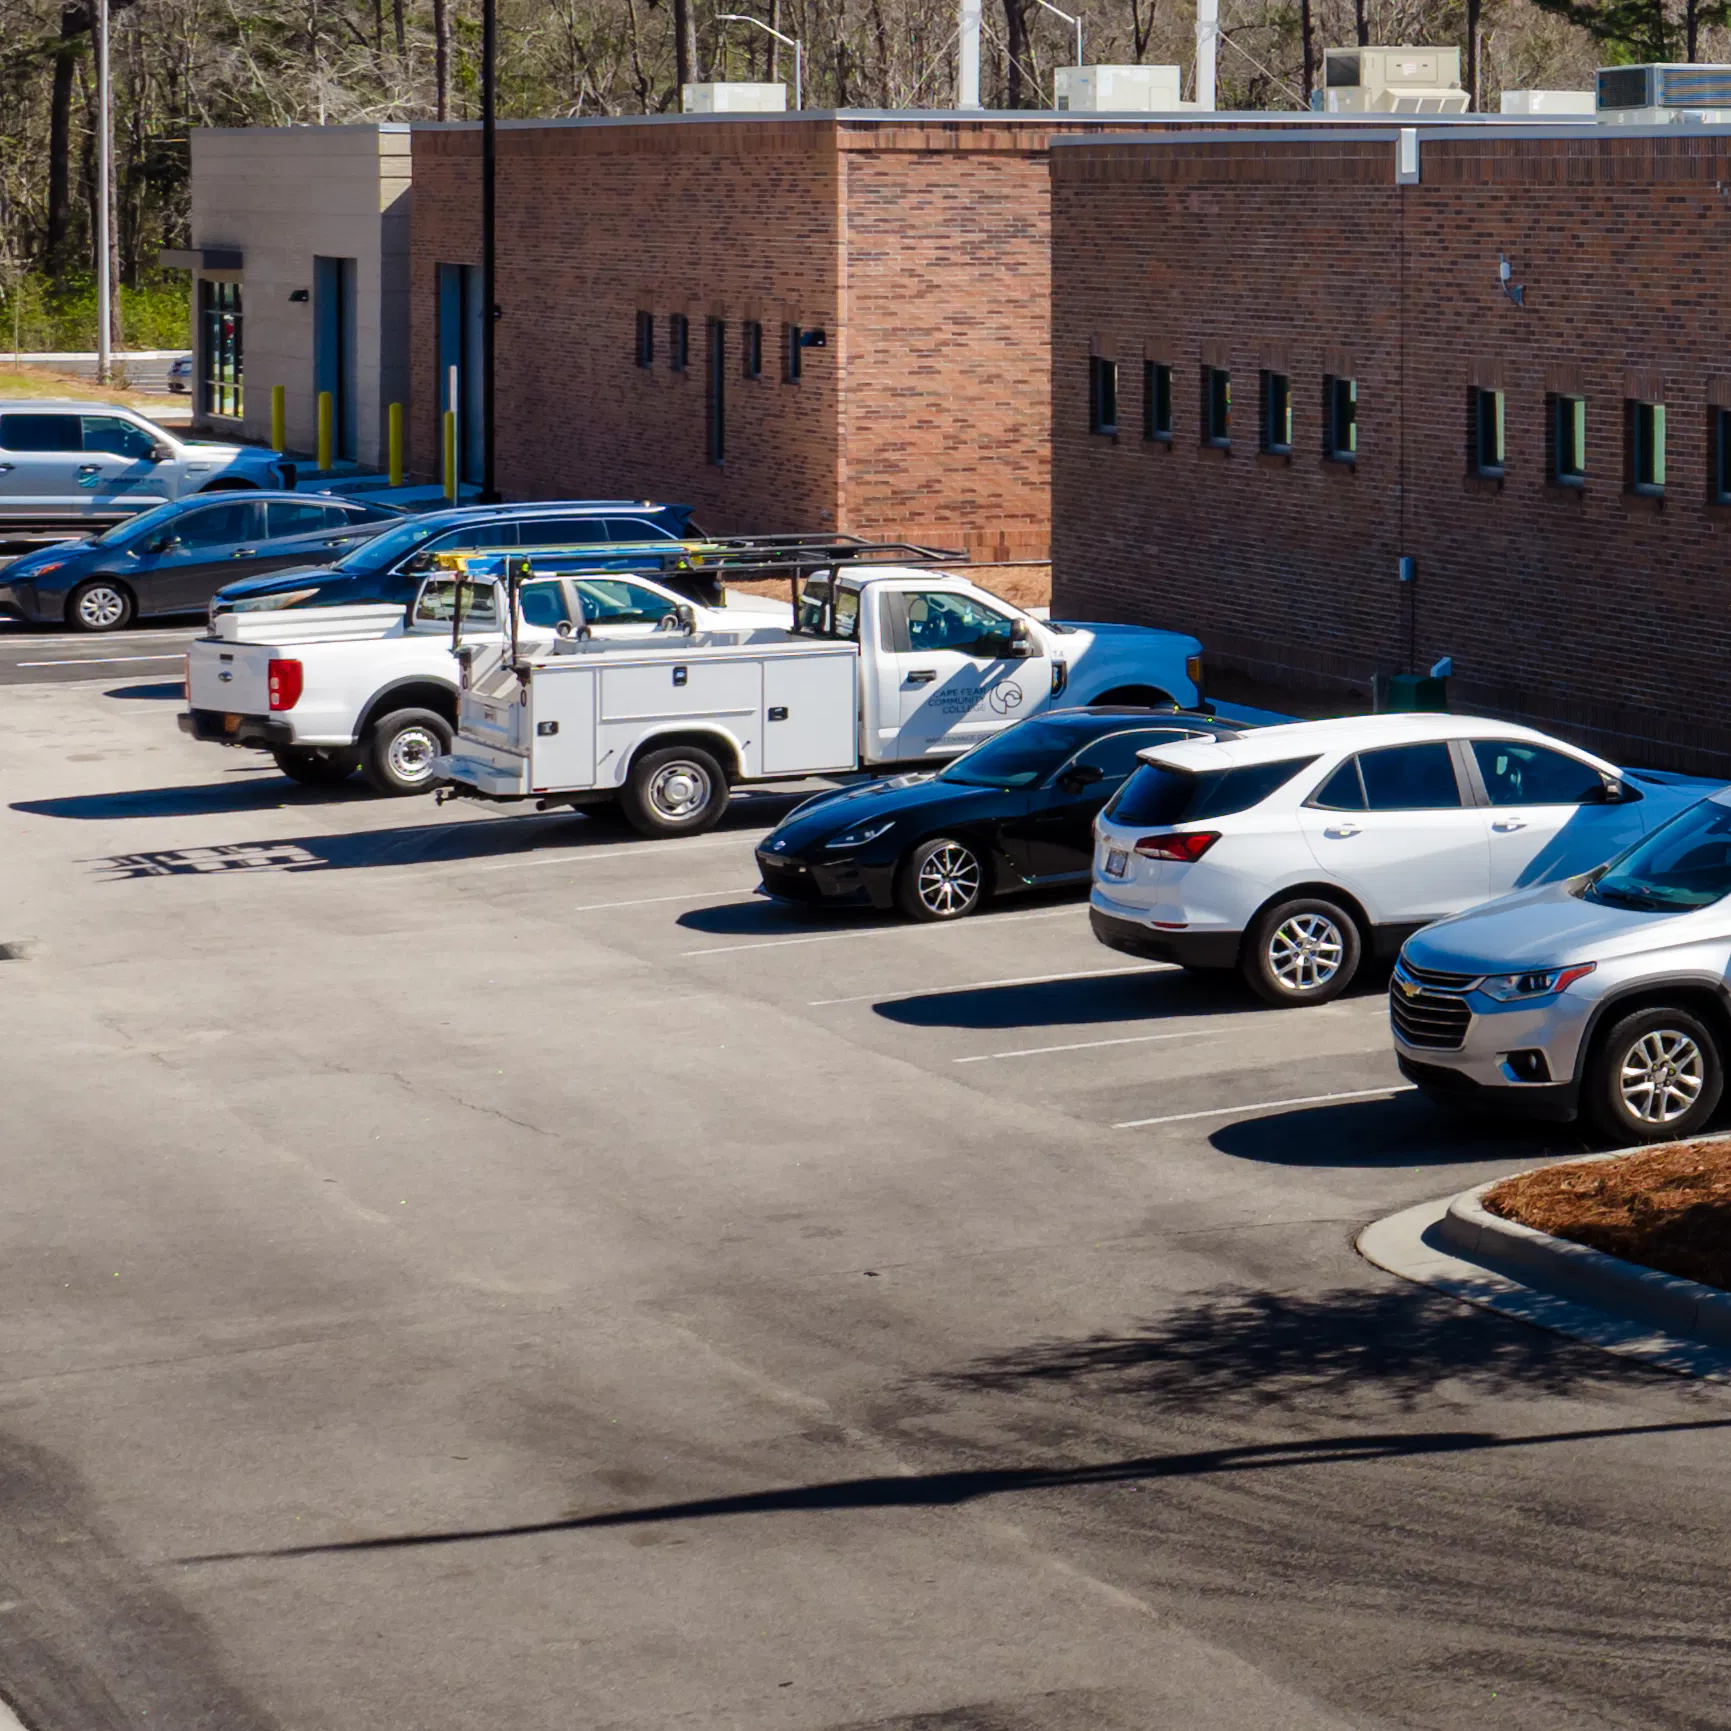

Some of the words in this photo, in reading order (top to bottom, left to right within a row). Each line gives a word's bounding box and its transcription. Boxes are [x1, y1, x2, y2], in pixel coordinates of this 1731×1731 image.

[933, 688, 958, 698] CAPE
[961, 687, 986, 696] FEAR
[928, 695, 985, 707] COMMUNITY
